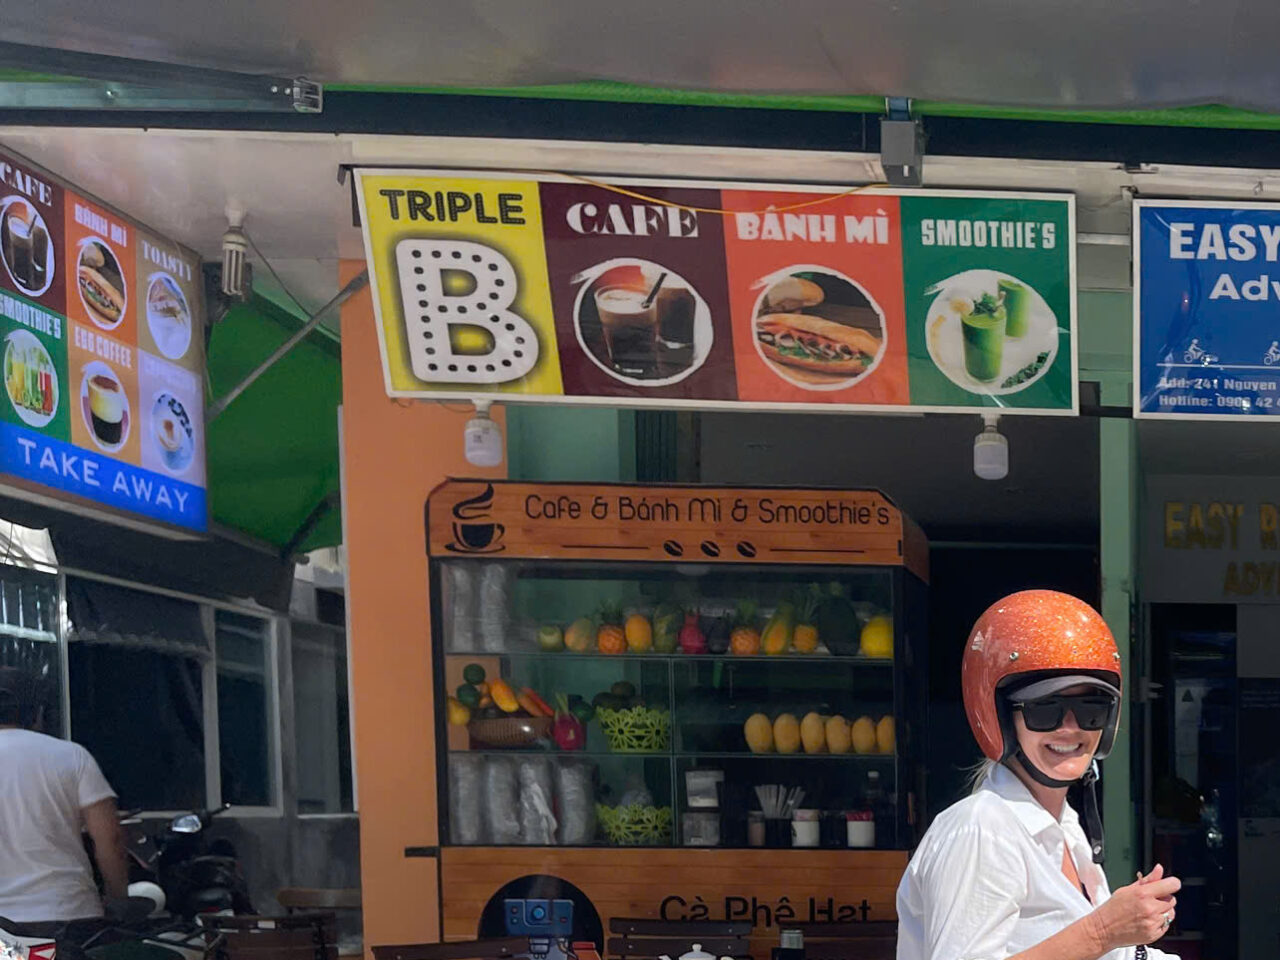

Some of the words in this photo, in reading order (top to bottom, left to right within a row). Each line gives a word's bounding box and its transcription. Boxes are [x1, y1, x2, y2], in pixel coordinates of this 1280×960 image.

[379, 189, 526, 226] TRIPLE
[566, 202, 699, 238] CAFE
[734, 205, 836, 243] BÁNH
[844, 208, 890, 246] MÌ
[920, 218, 1056, 250] SMOOTHIE'S
[395, 238, 539, 384] B
[1159, 395, 1213, 407] Hotline:
[1255, 397, 1273, 408] 42
[1224, 379, 1277, 391] Nguyen
[17, 437, 100, 487] TAKE
[112, 471, 189, 513] AWAY
[524, 494, 581, 520] Cafe
[591, 495, 608, 520] &
[618, 496, 679, 521] Bánh
[731, 498, 748, 522] &
[758, 497, 890, 526] Smoothie's
[1163, 502, 1244, 550] EASY
[725, 896, 795, 928] Phê
